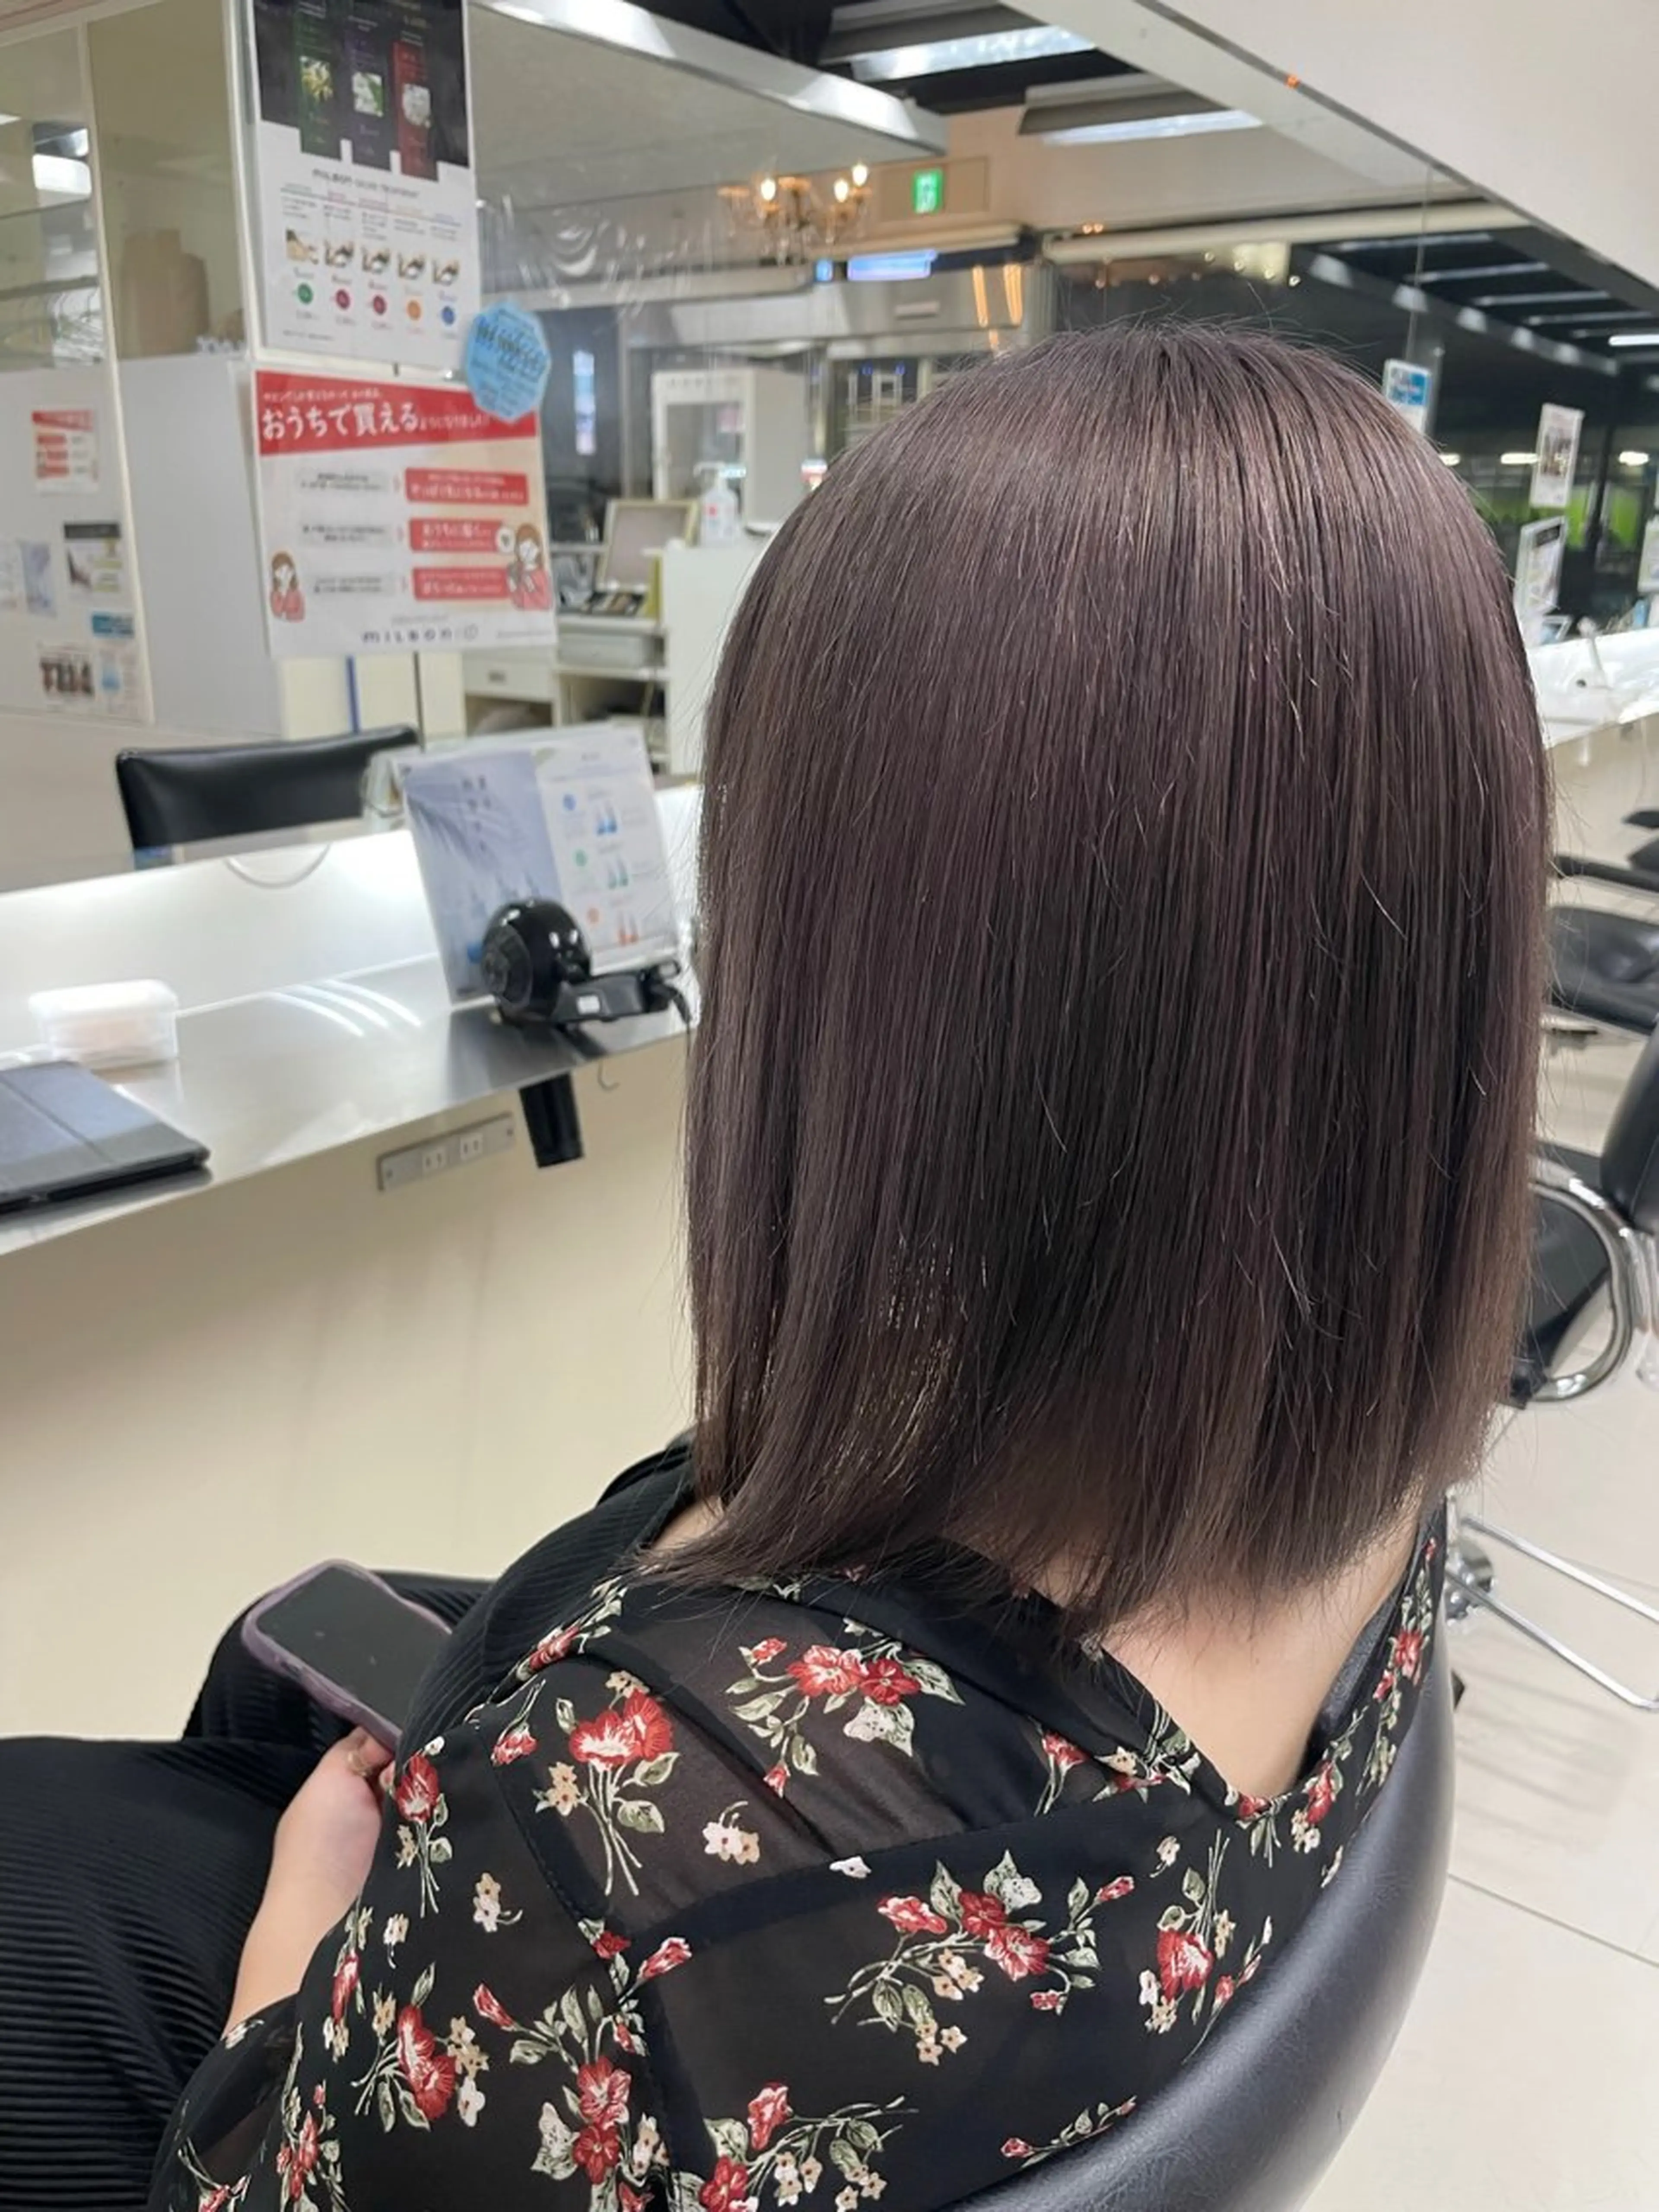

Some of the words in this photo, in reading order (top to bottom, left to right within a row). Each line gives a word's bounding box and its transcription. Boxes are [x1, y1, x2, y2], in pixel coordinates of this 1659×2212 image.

[262, 402, 418, 440] おうちで買える
